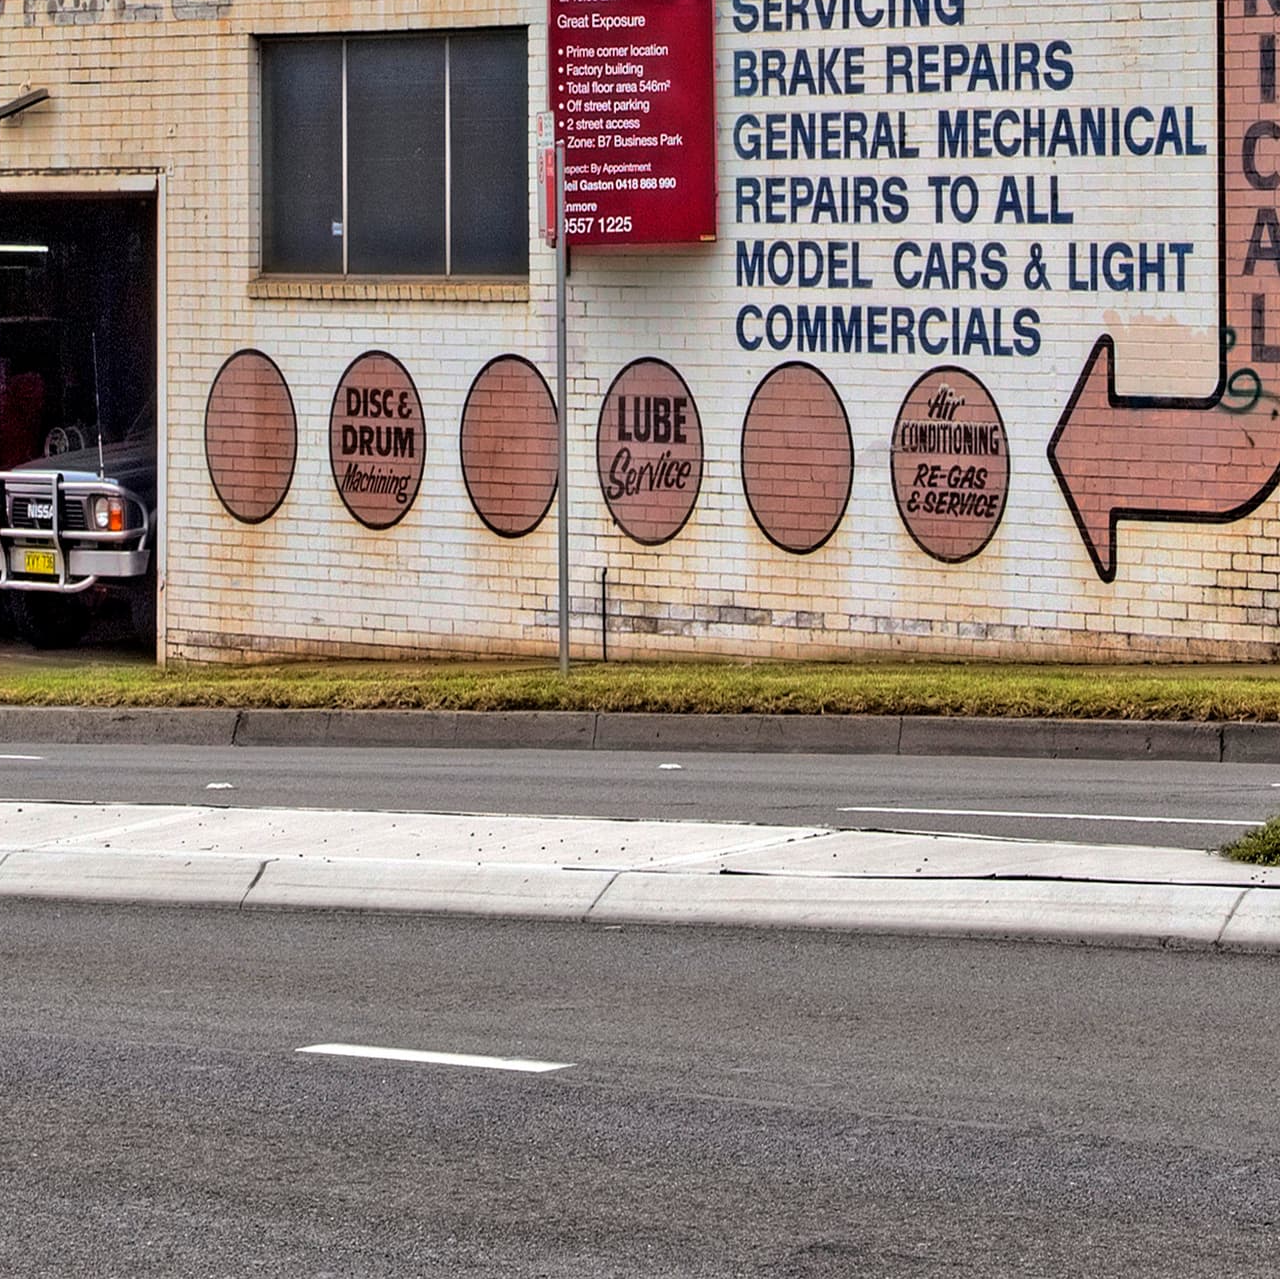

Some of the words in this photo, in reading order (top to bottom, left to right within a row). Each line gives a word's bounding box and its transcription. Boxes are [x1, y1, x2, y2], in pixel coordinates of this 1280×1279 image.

[556, 14, 589, 29] Great
[591, 13, 646, 31] Exposure
[566, 45, 595, 58] Prime
[596, 45, 628, 57] corner
[630, 44, 669, 57] location
[566, 63, 603, 78] Factory
[605, 61, 644, 78] building
[733, 46, 866, 97] BRAKE
[886, 39, 1075, 94] REPAIRS
[566, 81, 590, 94] Total
[591, 80, 614, 93] floor
[615, 82, 637, 93] area
[566, 99, 582, 113] Off
[584, 99, 611, 112] street
[613, 98, 650, 114] parking
[566, 118, 574, 130] 2
[576, 118, 604, 130] street
[605, 118, 640, 130] access
[732, 111, 919, 160] GENERAL
[937, 106, 1208, 158] MECHANICAL
[567, 135, 596, 149] Zone:
[597, 135, 612, 148] B7
[613, 133, 658, 148] Business
[660, 133, 684, 147] Park
[564, 164, 589, 176] spect:
[590, 163, 601, 175] By
[602, 162, 652, 175] Appointment
[579, 179, 615, 192] Gaston
[615, 178, 639, 190] 0418
[564, 201, 598, 213] nmore
[735, 176, 909, 224] REPAIRS
[928, 175, 979, 224] TO
[994, 176, 1074, 224] ALL
[597, 215, 632, 233] 1225
[736, 240, 873, 289] MODEL
[893, 241, 1009, 291] CARS
[1023, 242, 1052, 291] &
[1068, 242, 1195, 292] LIGHT
[735, 304, 1042, 357] COMMERCIALS
[346, 387, 393, 418] DISC
[397, 391, 412, 419] &
[618, 396, 687, 444] LUBE
[341, 425, 415, 458] DRUM
[901, 422, 999, 455] CONDITIONING
[341, 463, 412, 504] Machining
[606, 447, 692, 500] Service
[913, 463, 988, 490] RE-GAS
[27, 503, 54, 520] NISSA
[907, 491, 920, 513] &
[922, 491, 999, 518] SERVICE
